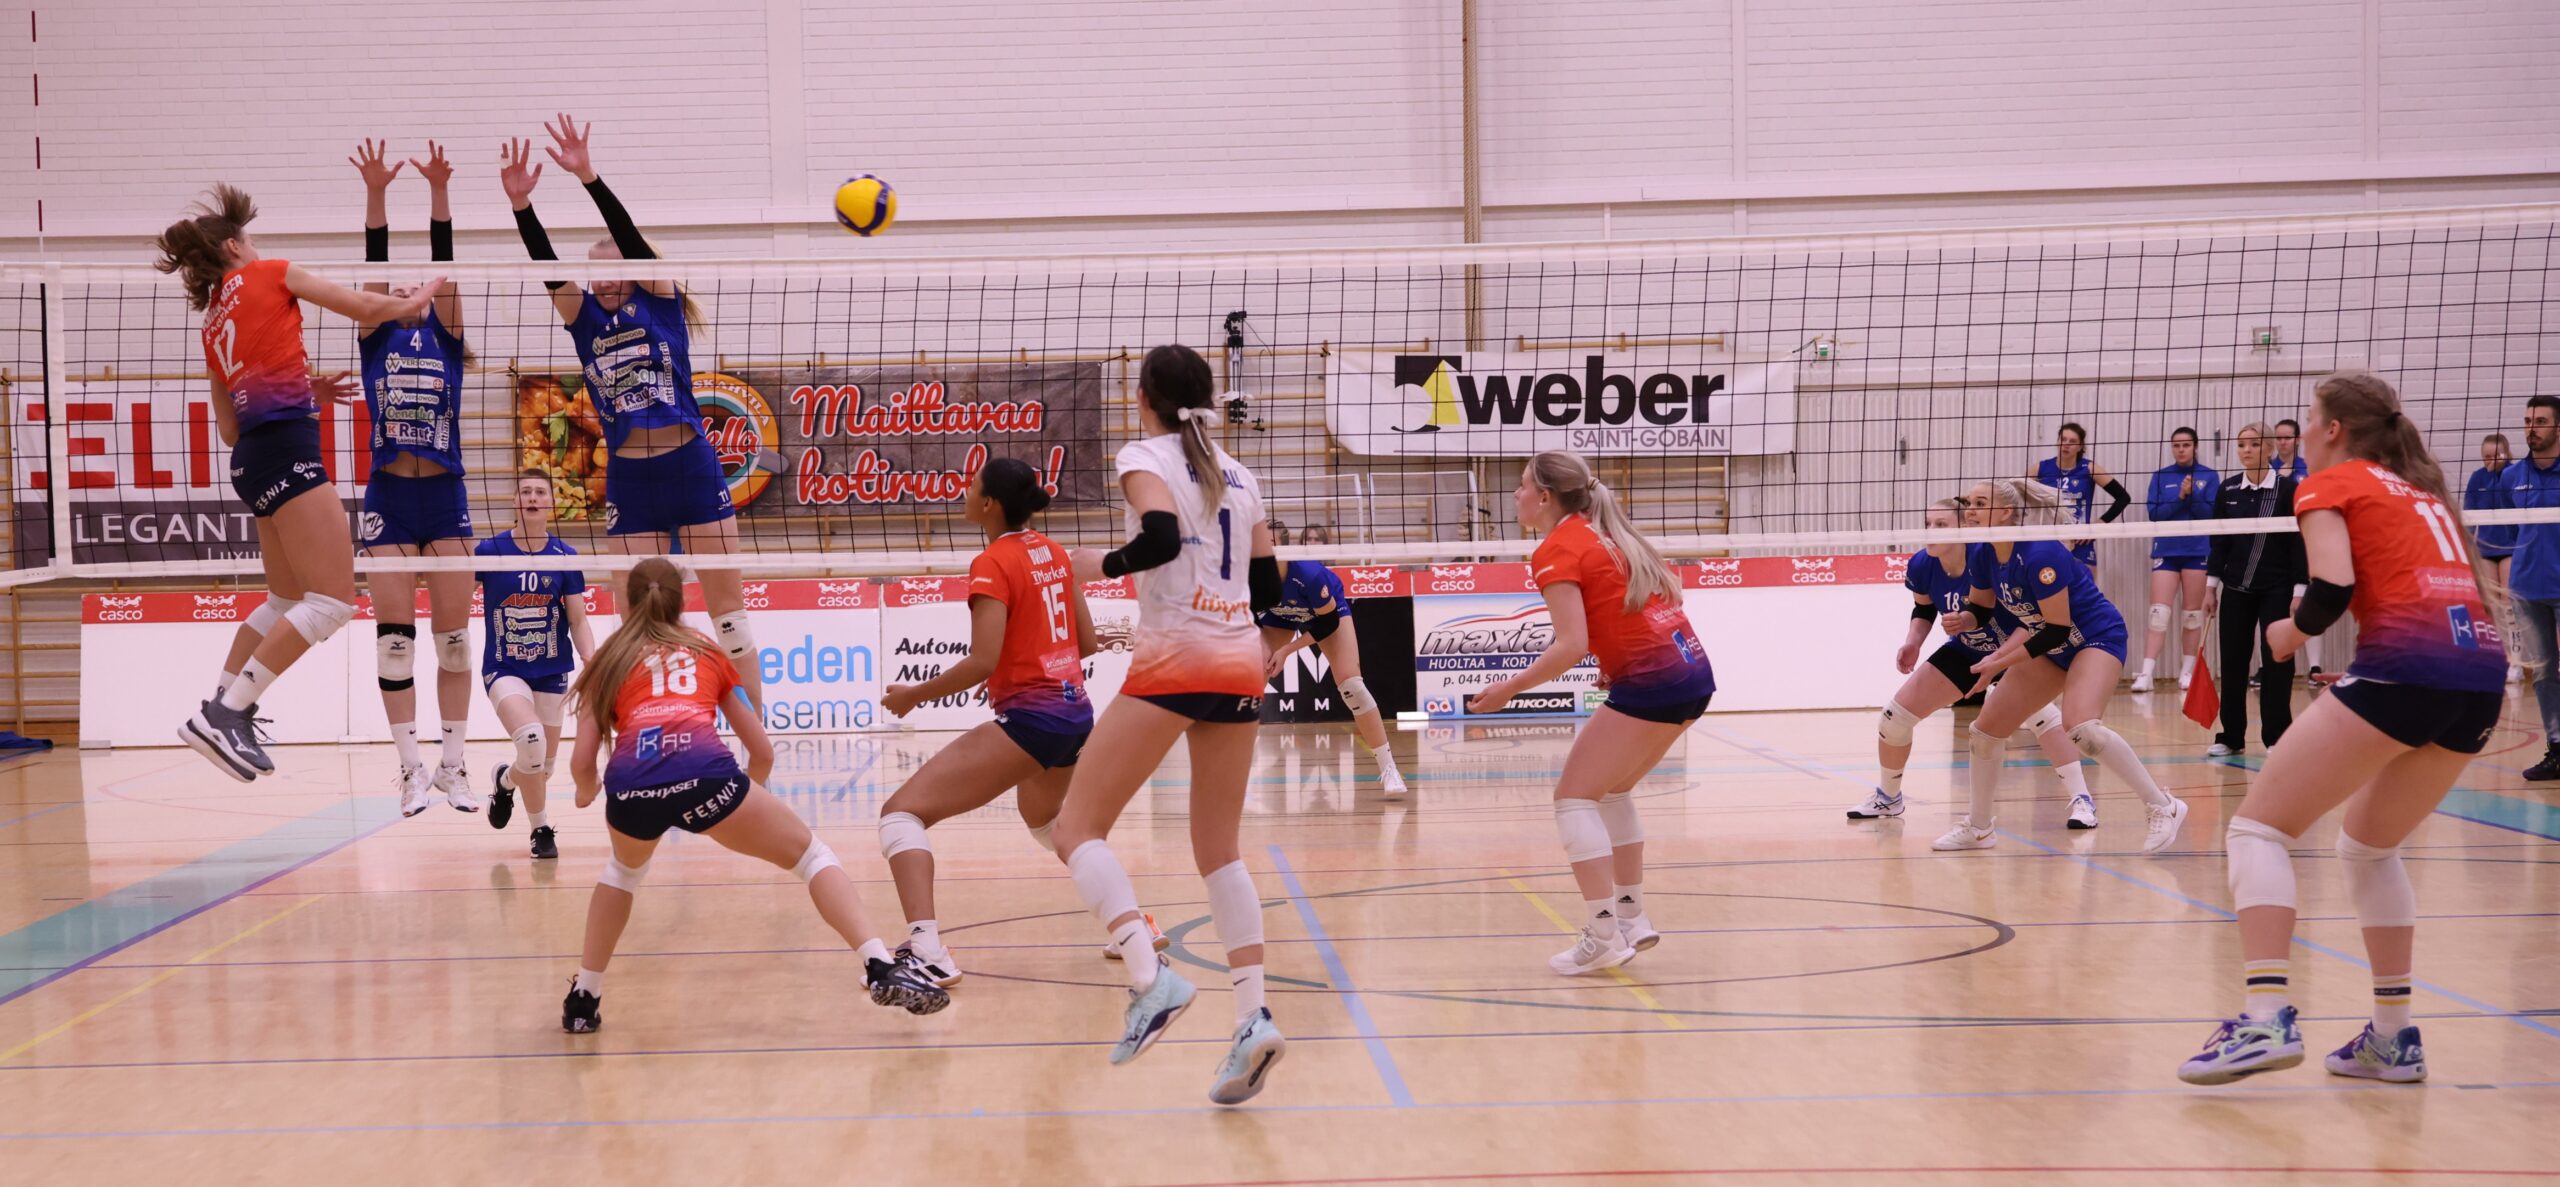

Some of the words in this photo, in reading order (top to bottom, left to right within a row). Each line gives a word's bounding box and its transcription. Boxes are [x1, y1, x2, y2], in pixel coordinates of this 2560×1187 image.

[213, 319, 244, 380] 12
[409, 330, 422, 351] 4
[1457, 356, 1725, 427] weber
[693, 379, 769, 427] SKAHVILA
[791, 381, 1044, 437] Maittavaa
[1573, 429, 1725, 449] SAINT-GOBAIN
[2414, 501, 2471, 564] 11
[1218, 508, 1231, 580] 1
[518, 572, 539, 592] 10
[1350, 582, 1394, 593] casco
[1431, 579, 1475, 591] casco
[1698, 574, 1742, 585] casco
[1791, 572, 1836, 583] casco
[500, 593, 553, 607] AVANT
[743, 597, 769, 608] sco
[818, 595, 861, 607] casco
[900, 593, 943, 604] casco
[1944, 591, 1960, 611] 18
[98, 609, 142, 620] casco
[193, 608, 236, 619] casco
[1041, 582, 1069, 643] 15
[895, 638, 972, 656] Autom
[1420, 622, 1555, 655] maxia
[759, 635, 872, 684] eden
[1429, 657, 1486, 670] HUOLTAA
[643, 651, 698, 697] 18
[1458, 675, 1481, 685] 044
